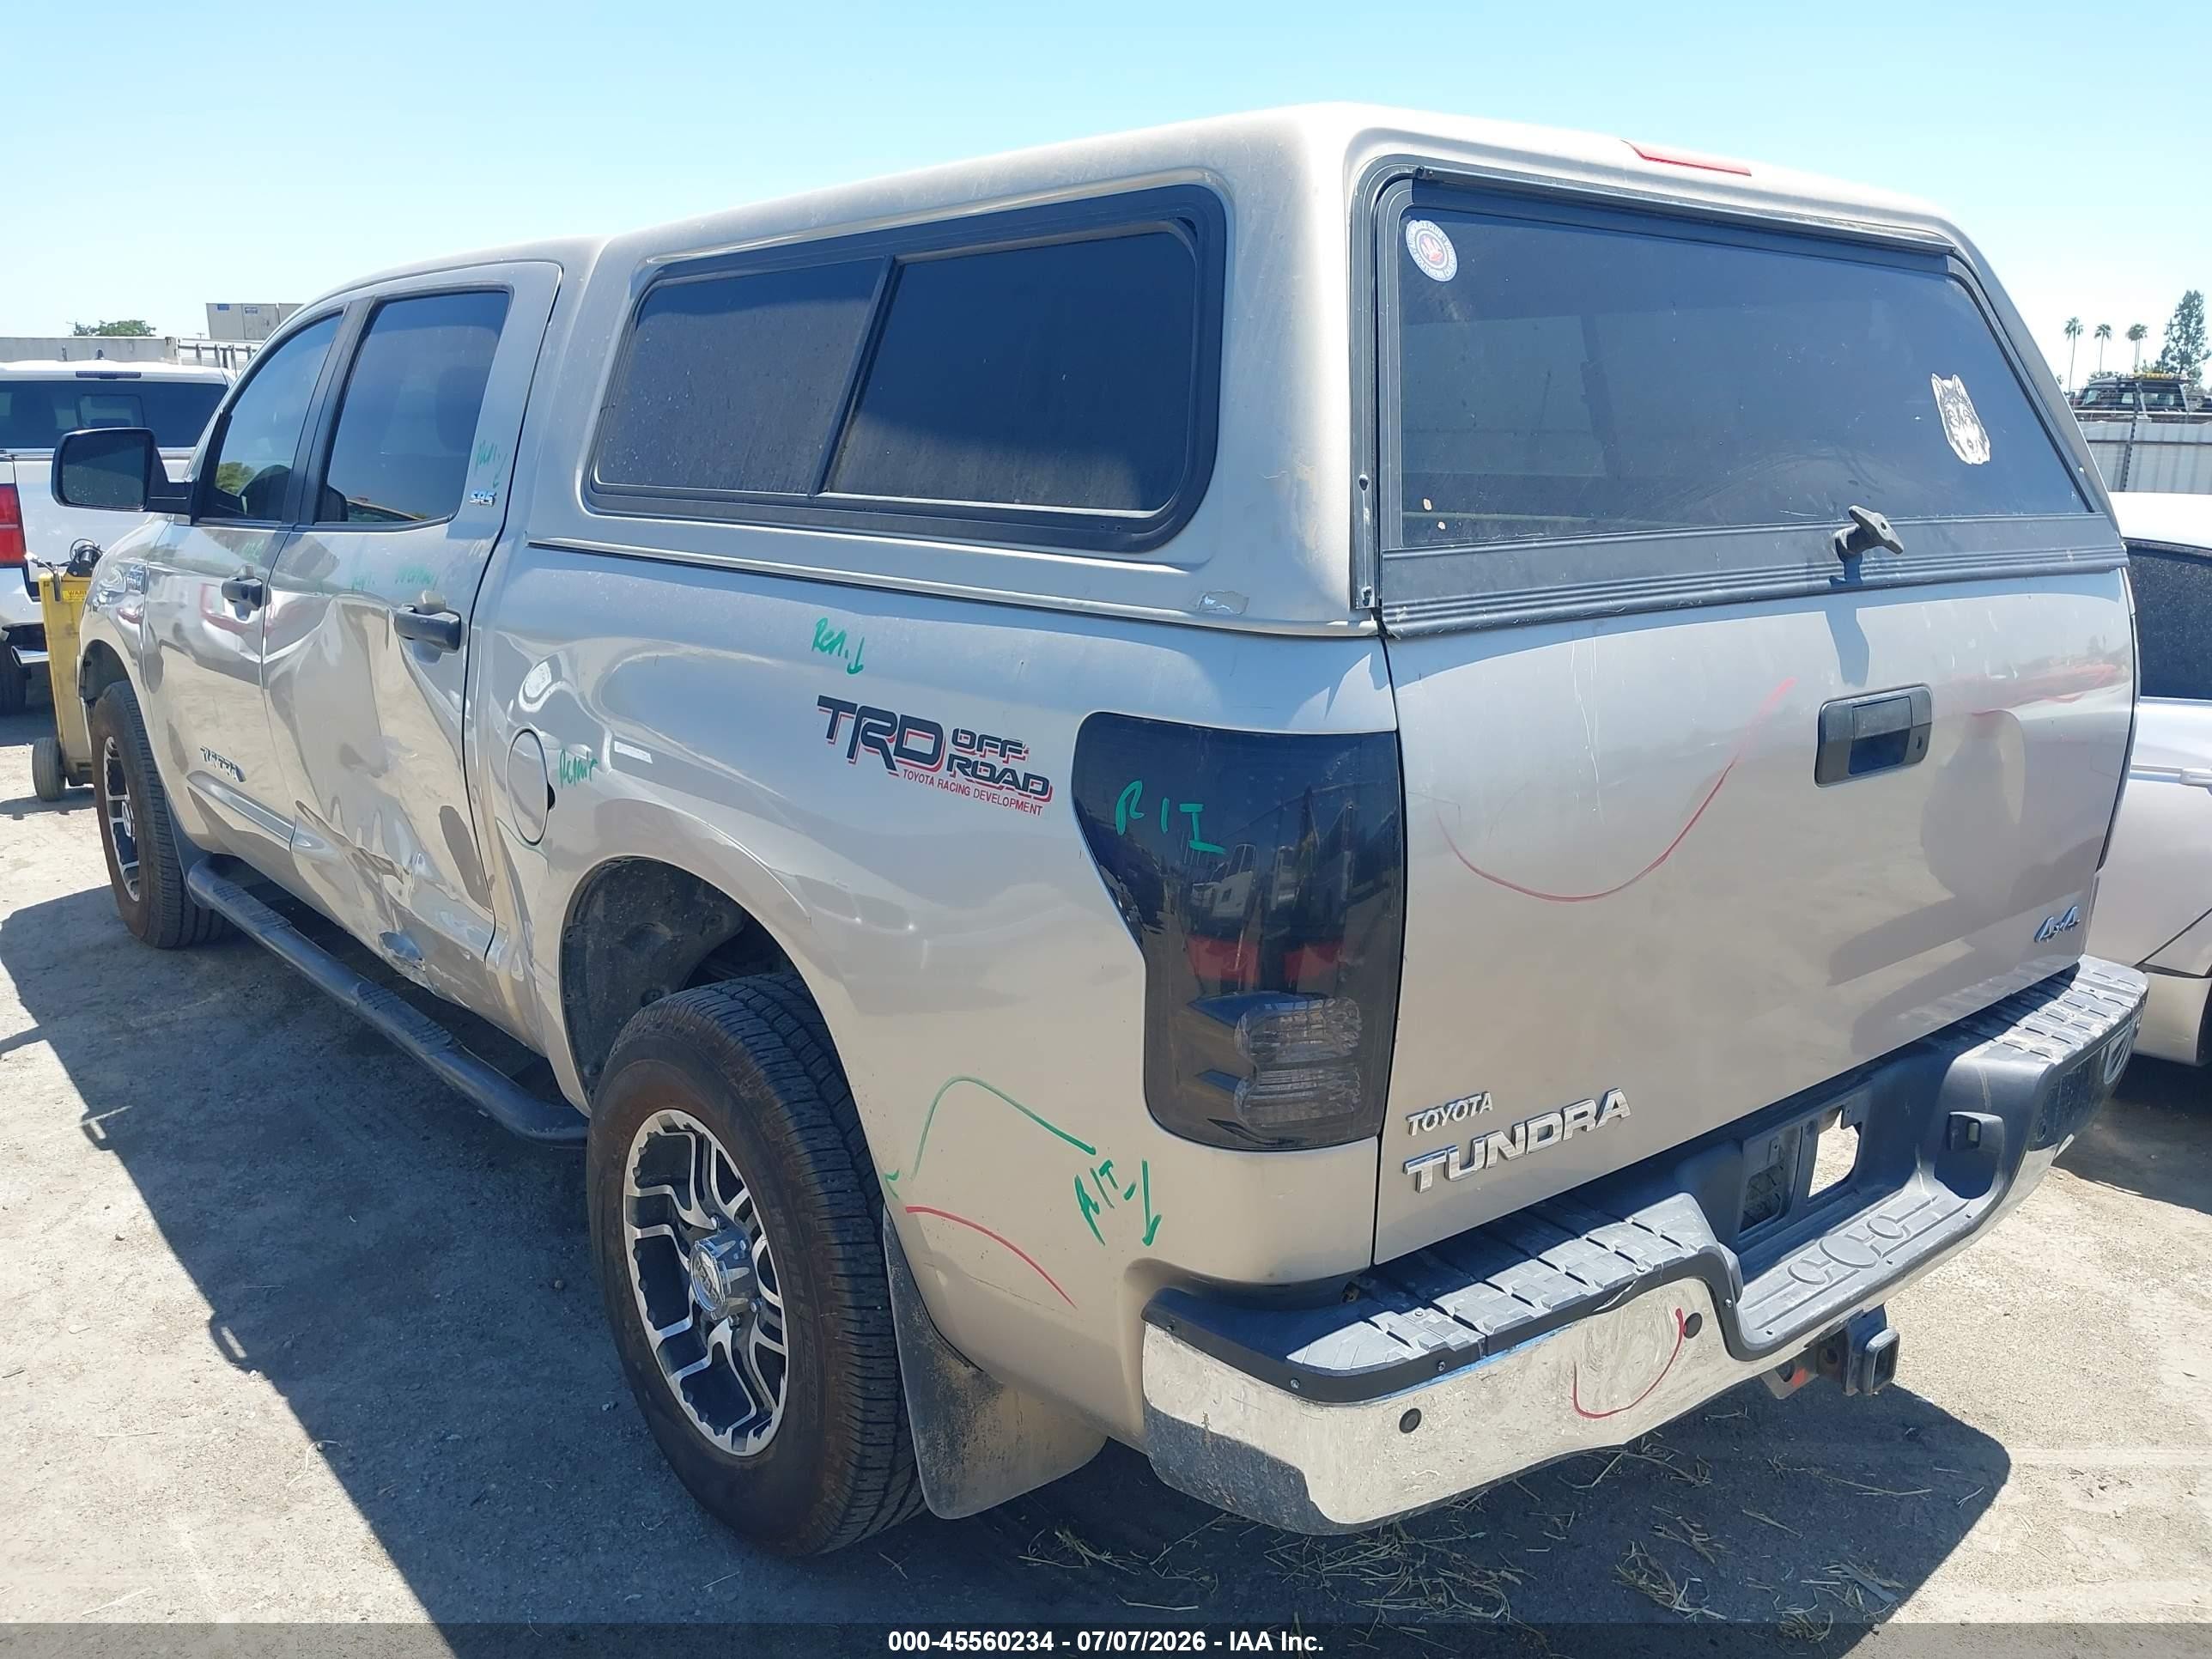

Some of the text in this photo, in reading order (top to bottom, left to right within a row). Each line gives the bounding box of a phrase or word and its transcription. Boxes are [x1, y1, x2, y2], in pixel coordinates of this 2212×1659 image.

[817, 694, 948, 776] TRD
[951, 727, 1030, 764] OFF
[902, 768, 1044, 817] TOYOTA RACING DEVELOPMENT
[945, 754, 1054, 804] ROAD
[2033, 905, 2081, 944] 4x4
[1406, 1091, 1494, 1137] TOYOTA
[1402, 1087, 1632, 1194] TUNDRA
